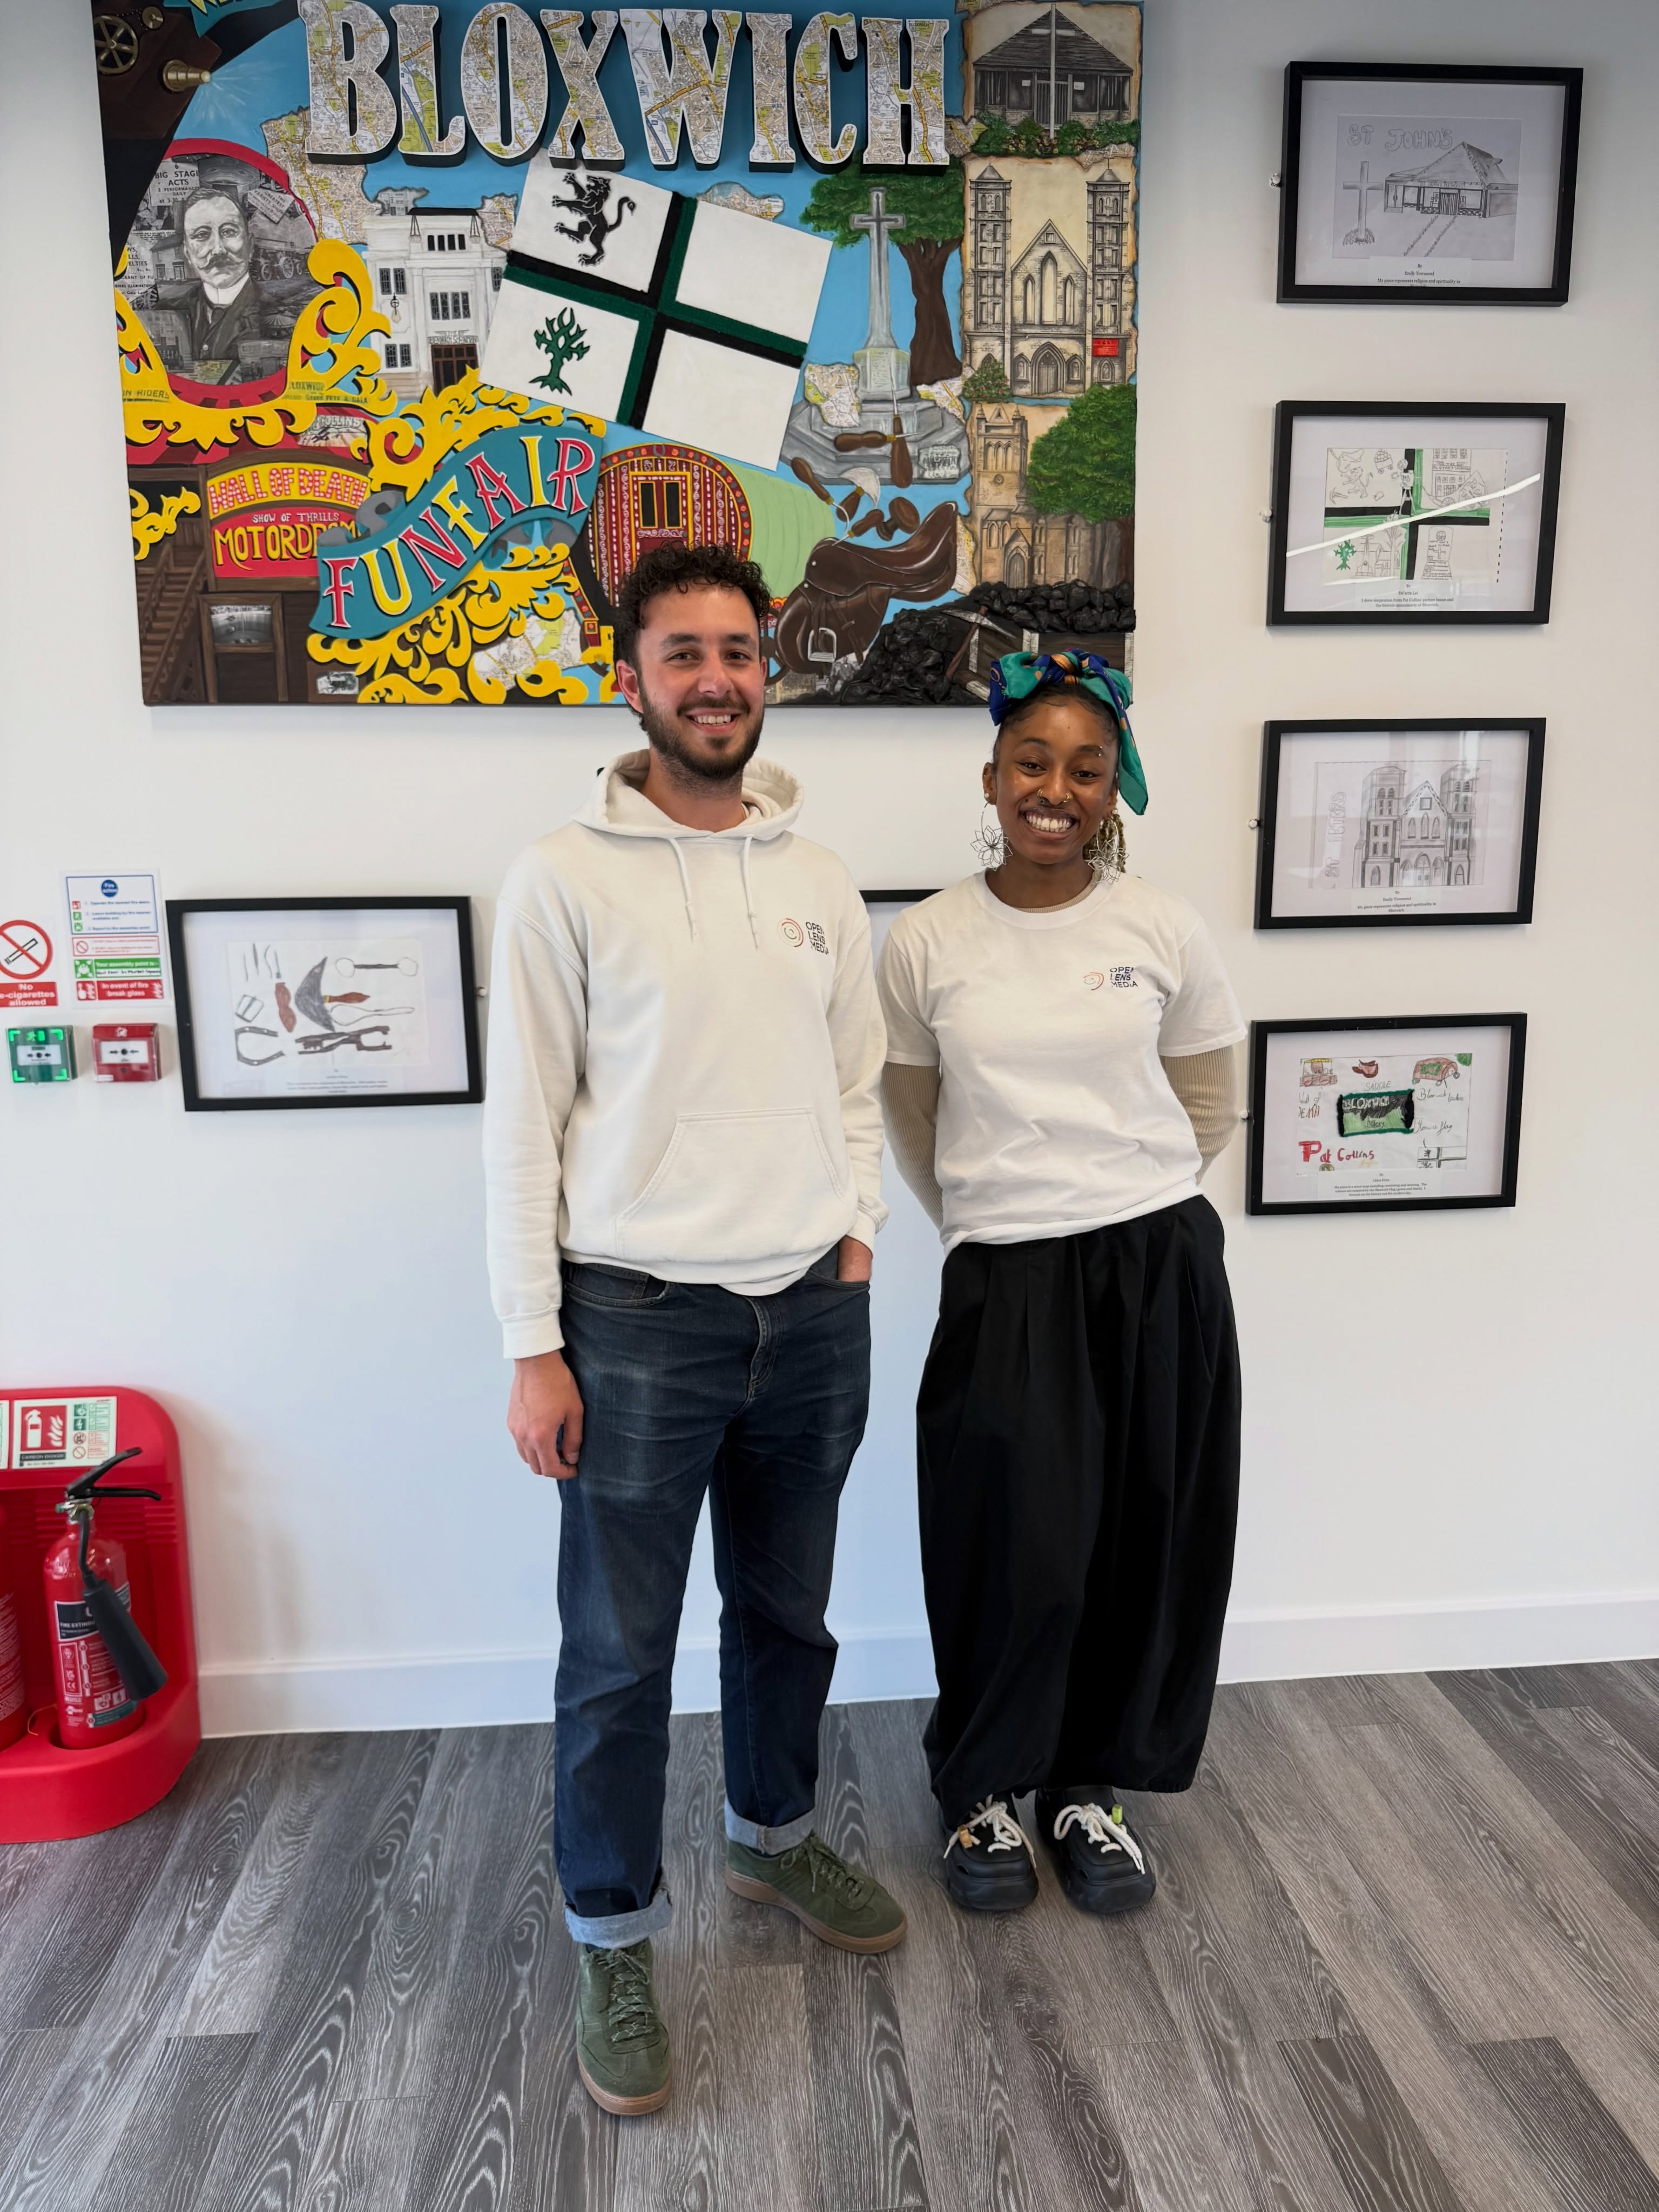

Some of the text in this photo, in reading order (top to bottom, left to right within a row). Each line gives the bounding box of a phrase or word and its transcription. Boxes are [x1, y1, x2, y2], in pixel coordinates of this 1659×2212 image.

[297, 0, 950, 168] BLOXWICH
[1347, 124, 1453, 151] ST JOHN'S
[137, 389, 170, 399] RIDERS
[209, 468, 369, 515] WALL OF DEATH
[252, 512, 340, 523] SHOW OF THRILLS
[322, 434, 596, 629] FUNFAIR
[808, 930, 826, 945] LENS
[810, 940, 829, 955] MEDIA
[1110, 973, 1131, 981] LENS
[0, 991, 56, 1000] e-cigarettes
[9, 997, 47, 1006] allowed
[1365, 1081, 1392, 1091] SADDLE
[1299, 1091, 1310, 1104] Wall
[1298, 1105, 1320, 1119] DEATH
[1298, 1140, 1374, 1163] Pat Collins
